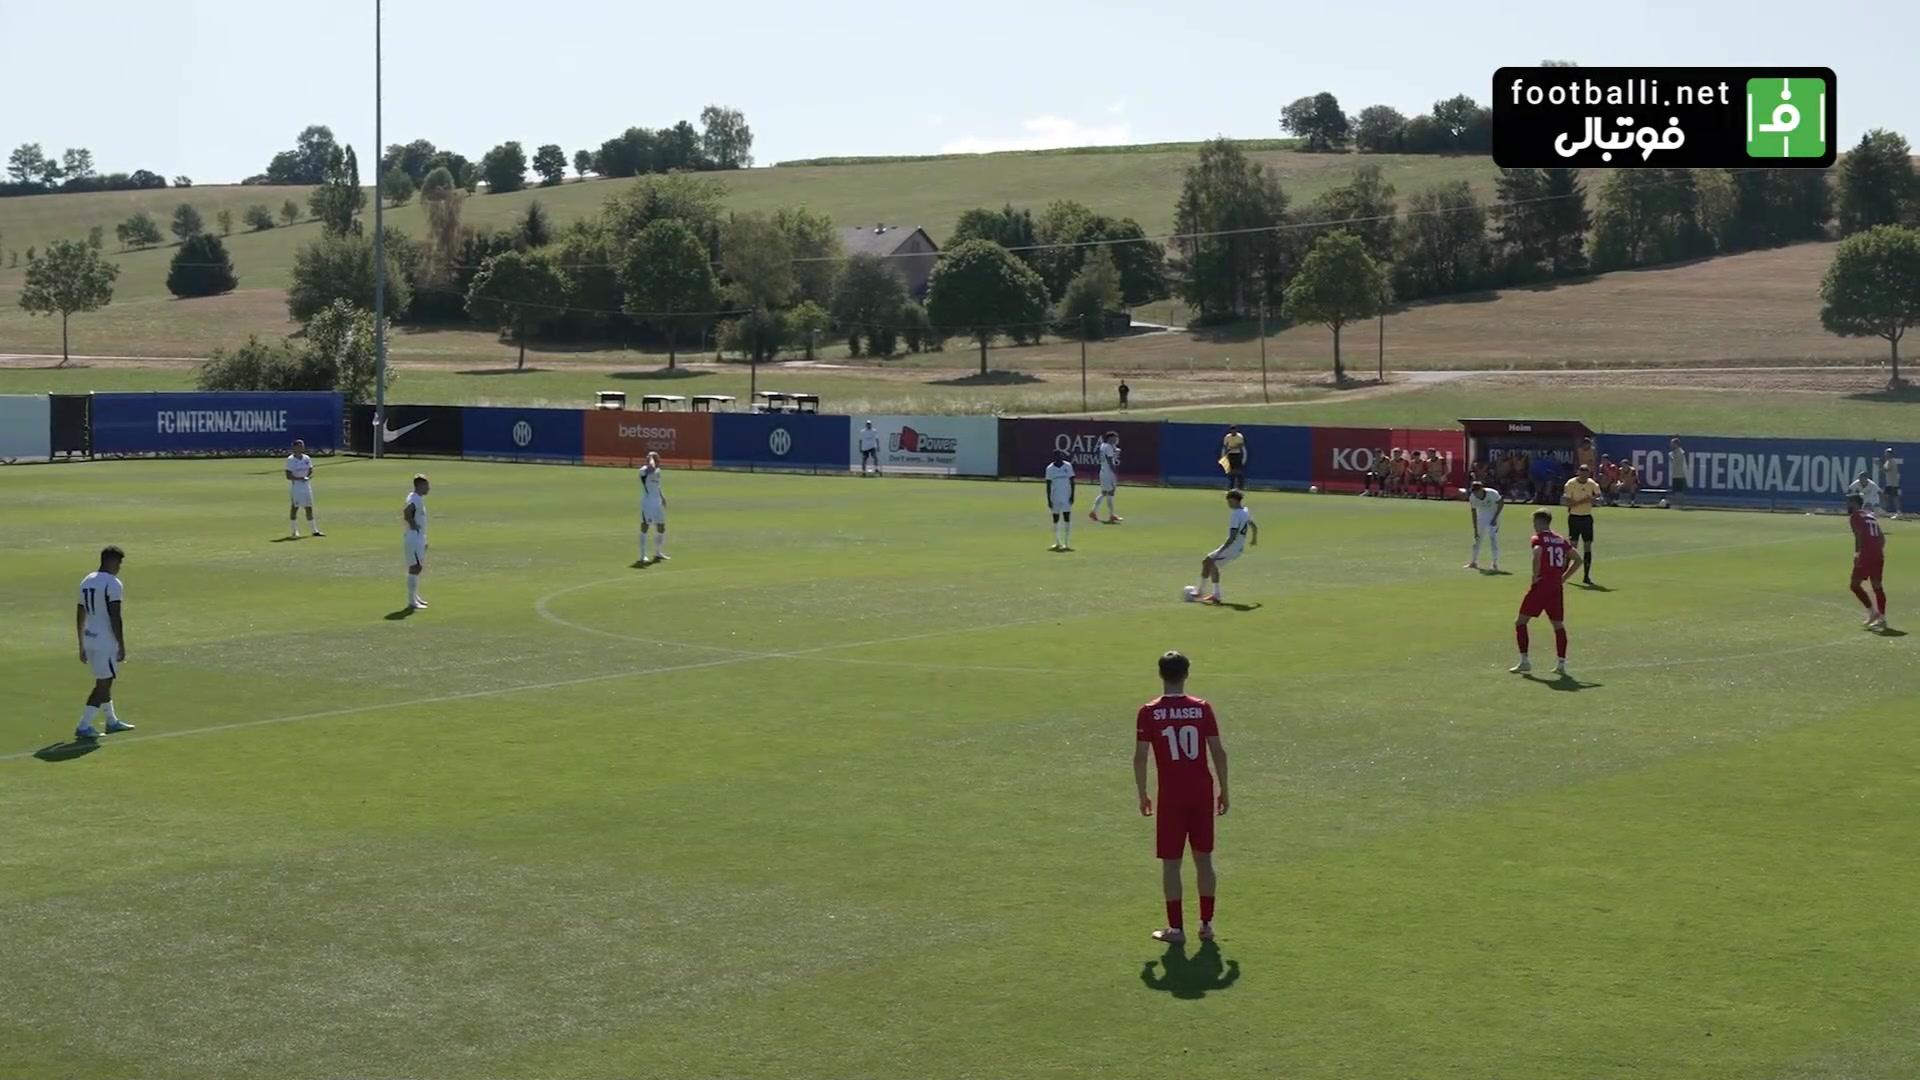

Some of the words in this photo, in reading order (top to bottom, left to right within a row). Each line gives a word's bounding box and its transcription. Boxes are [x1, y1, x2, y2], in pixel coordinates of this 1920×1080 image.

[157, 411, 175, 433] FC
[176, 410, 287, 433] INTERNAZIONALE
[618, 423, 676, 439] betsson
[1054, 433, 1120, 456] QATA
[1632, 450, 1664, 487] FC
[1547, 546, 1564, 567] 13
[82, 588, 96, 615] 11
[1153, 708, 1167, 720] SV
[1169, 707, 1203, 719] AASEN
[1161, 725, 1199, 761] 10
